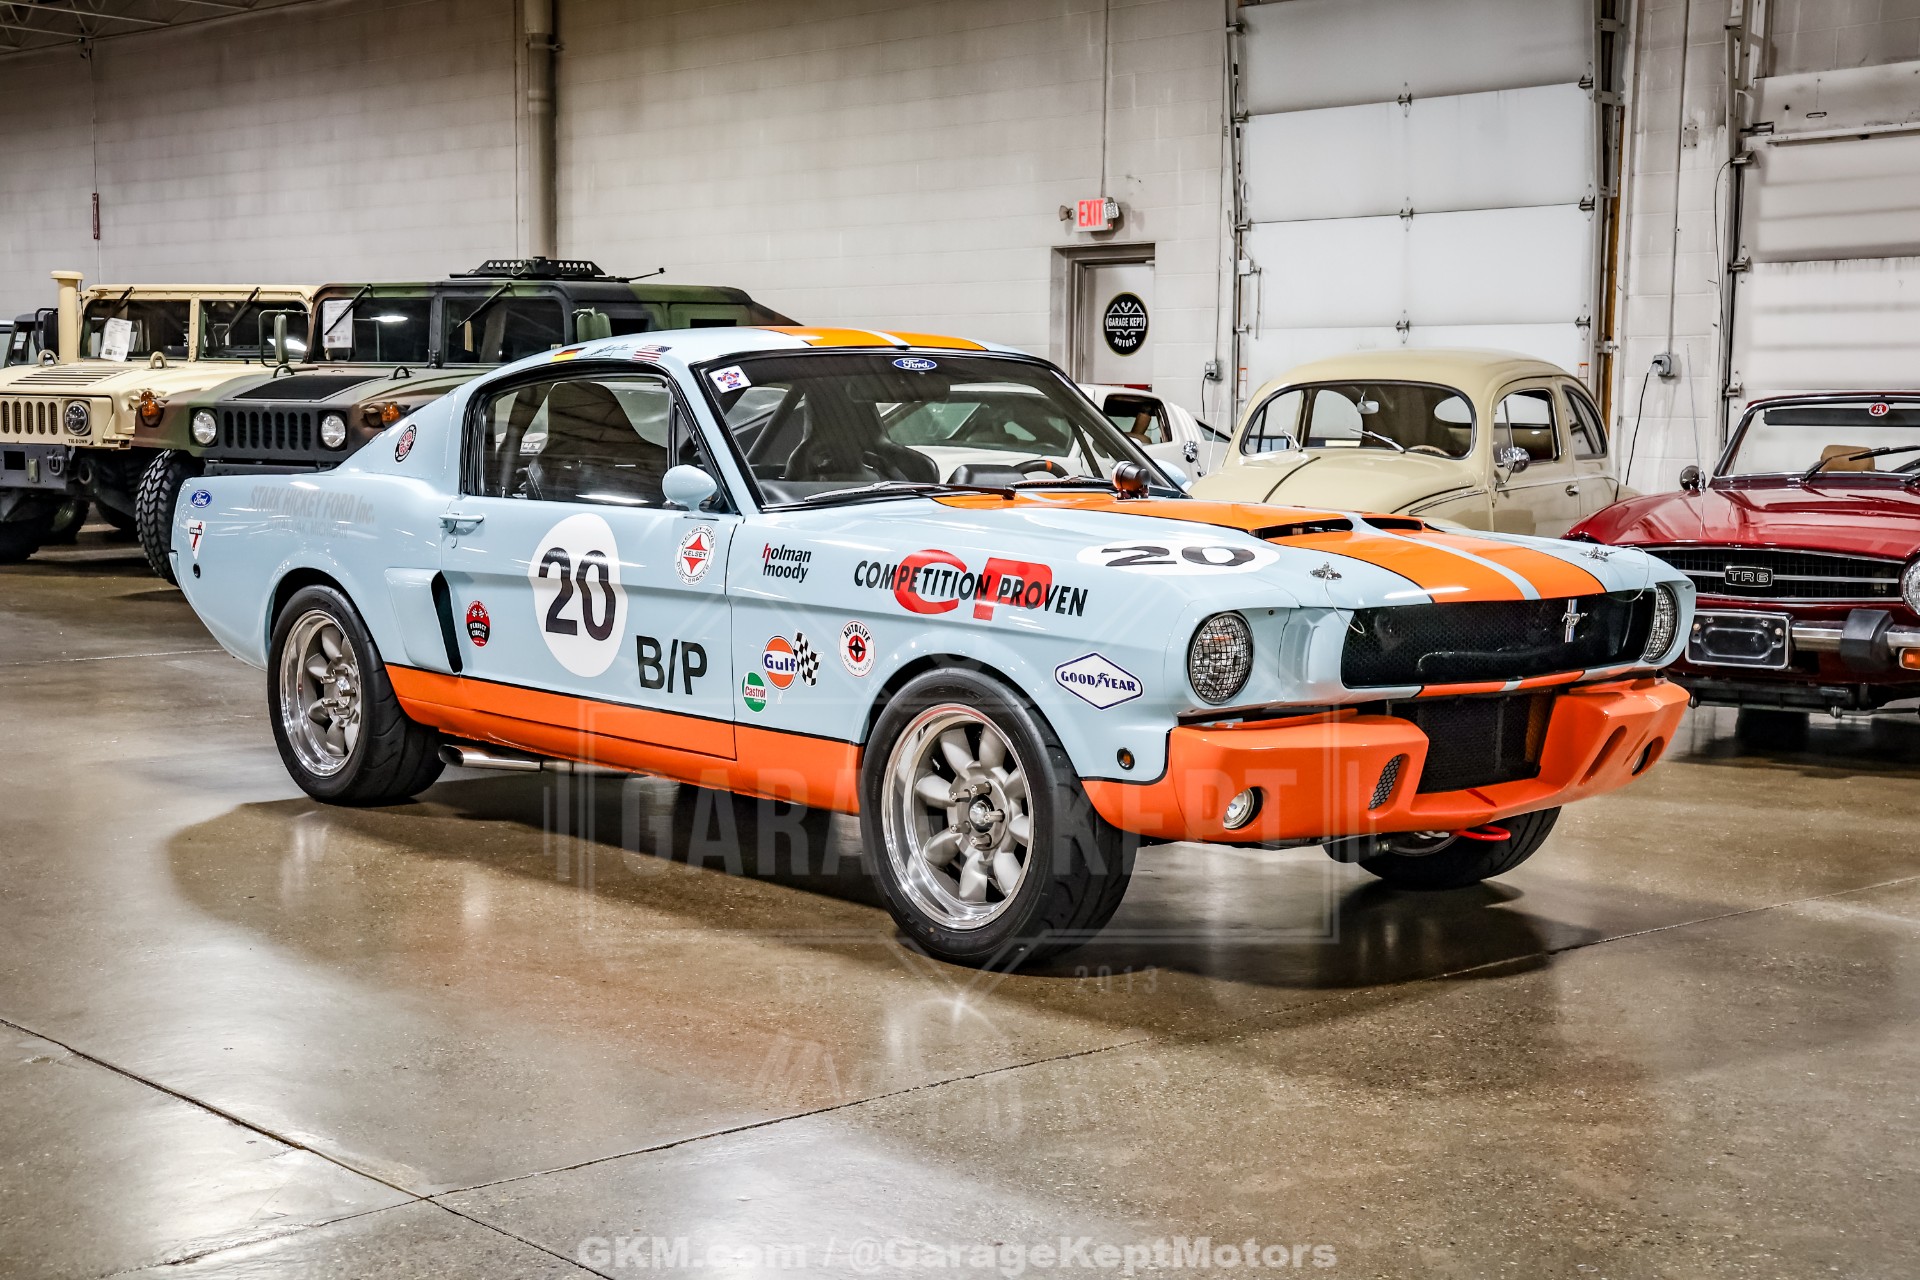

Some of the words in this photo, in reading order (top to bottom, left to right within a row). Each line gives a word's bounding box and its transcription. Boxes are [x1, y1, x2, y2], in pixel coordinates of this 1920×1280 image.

[1078, 200, 1104, 226] EXIT
[1108, 317, 1128, 327] GARAGE
[1129, 317, 1144, 326] KEPT
[1113, 336, 1137, 347] MOTORS
[902, 360, 930, 369] Ford
[193, 491, 209, 505] Ford
[250, 486, 284, 509] STARK
[323, 492, 356, 520] FORD
[762, 543, 812, 563] holman
[1101, 546, 1256, 566] 20
[763, 562, 809, 583] moody
[1728, 570, 1769, 583] TR6
[539, 547, 616, 641] 20
[854, 560, 992, 601] COMPETITION
[997, 577, 1088, 617] PROVEN
[844, 624, 871, 642] AUTOLITE
[636, 635, 708, 695] B/P
[763, 653, 796, 672] Gulf
[745, 685, 766, 698] Castrol
